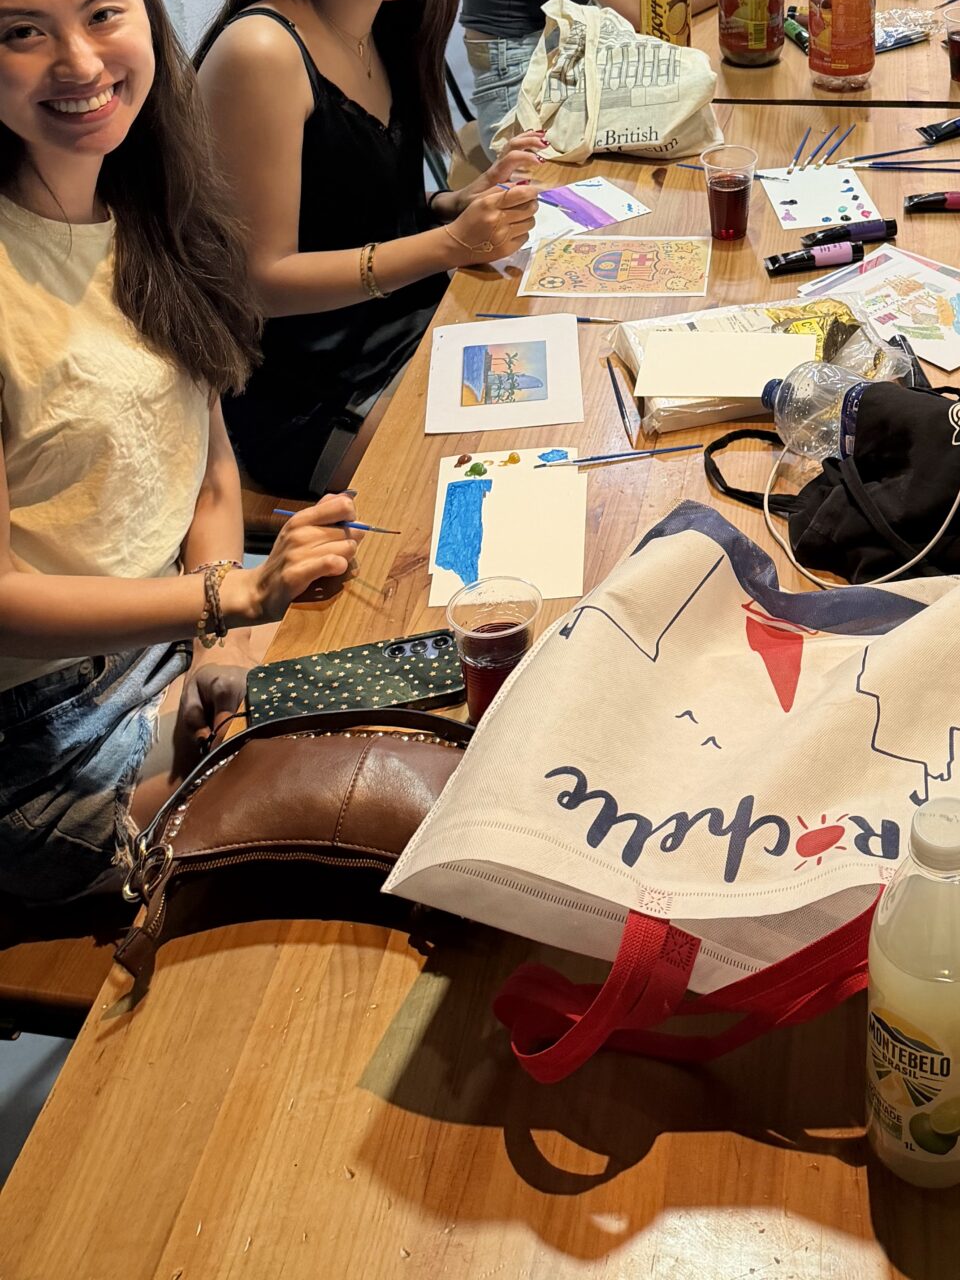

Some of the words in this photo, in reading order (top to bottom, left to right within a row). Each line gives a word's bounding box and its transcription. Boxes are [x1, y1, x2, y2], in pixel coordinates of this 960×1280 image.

[604, 126, 659, 146] British
[565, 271, 588, 289] GOAL
[868, 1013, 950, 1078] MONTEBELO
[882, 1052, 919, 1080] BRASIL
[904, 1141, 916, 1152] 1L
